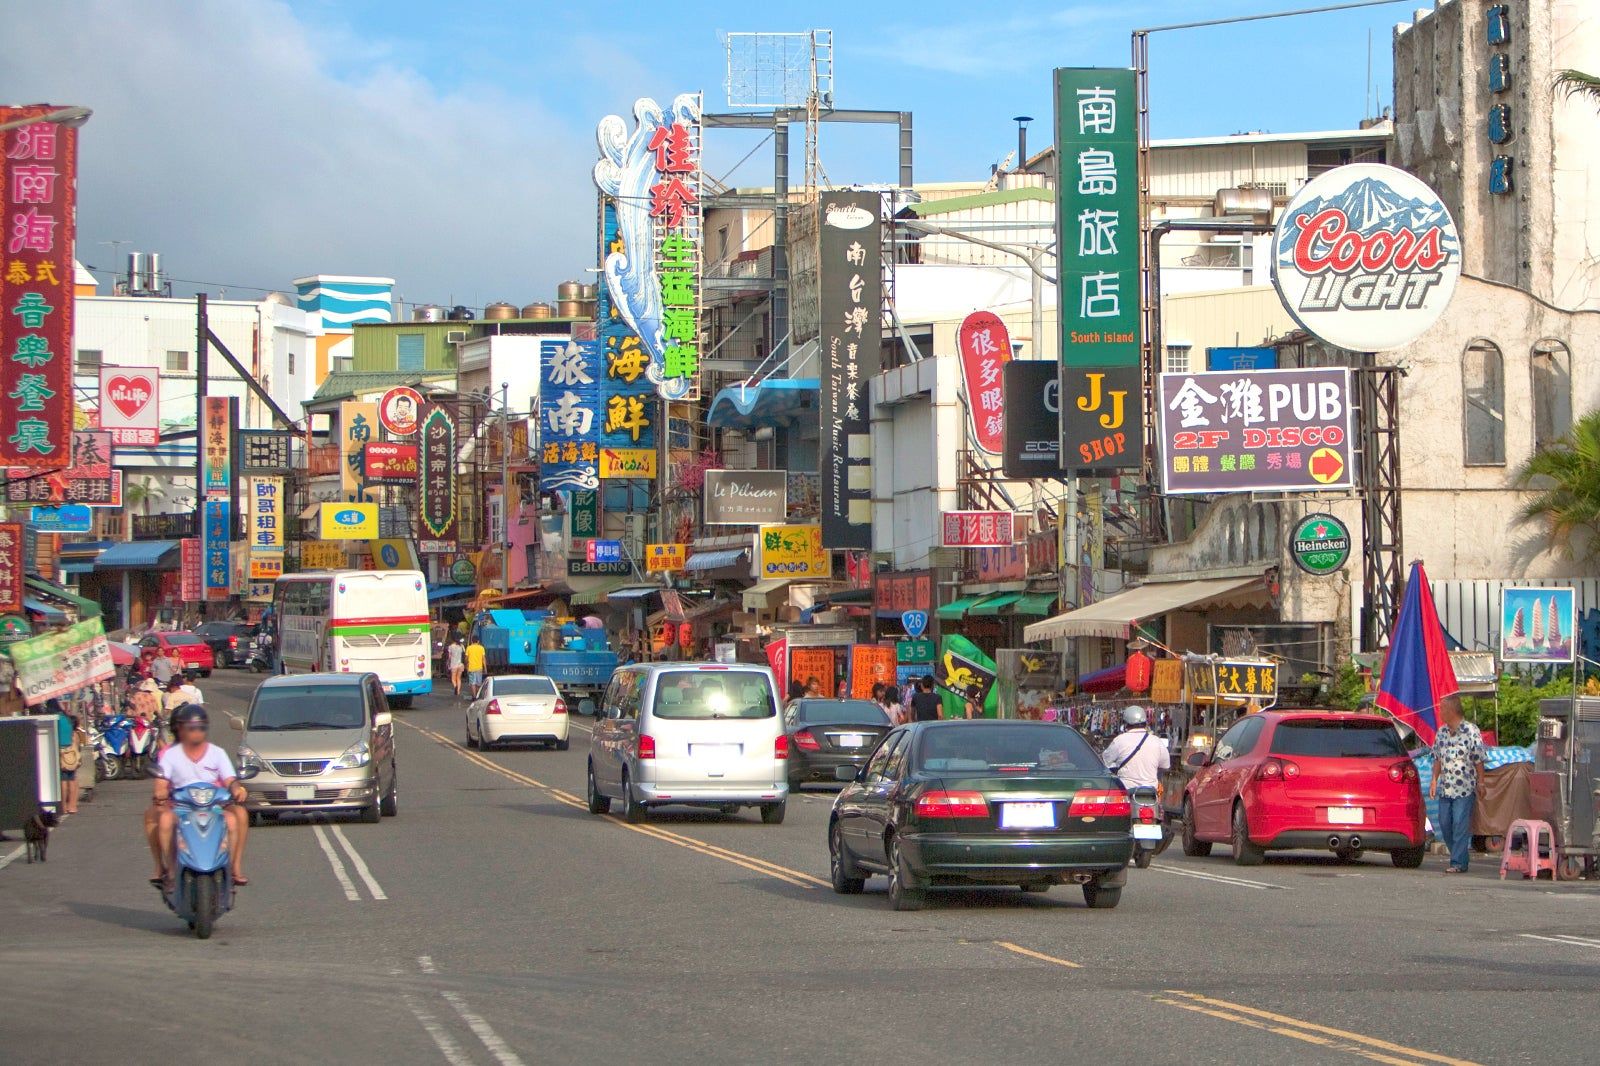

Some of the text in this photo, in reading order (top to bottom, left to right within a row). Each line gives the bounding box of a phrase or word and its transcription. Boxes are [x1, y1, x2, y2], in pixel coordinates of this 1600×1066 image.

[648, 123, 698, 228] 佳珍
[1077, 86, 1120, 318] 南島旅店
[1294, 208, 1448, 274] Coors
[5, 259, 61, 286] 泰式
[1298, 272, 1443, 312] LIGHT
[1071, 331, 1134, 343] South island
[112, 385, 148, 406] Hi-Life
[1268, 382, 1342, 422] PUB
[831, 335, 844, 516] South Taiwan Music Restaurant
[1173, 425, 1344, 449] 2F DISCO
[1079, 432, 1126, 463] SHOP
[1266, 452, 1302, 470] 秀場
[714, 483, 725, 498] Le
[256, 483, 277, 546] 帥哥租車
[945, 515, 1013, 544] 隱形眼鏡
[1297, 539, 1346, 552] Heineken
[649, 557, 683, 568] 停車場
[908, 613, 922, 629] 26
